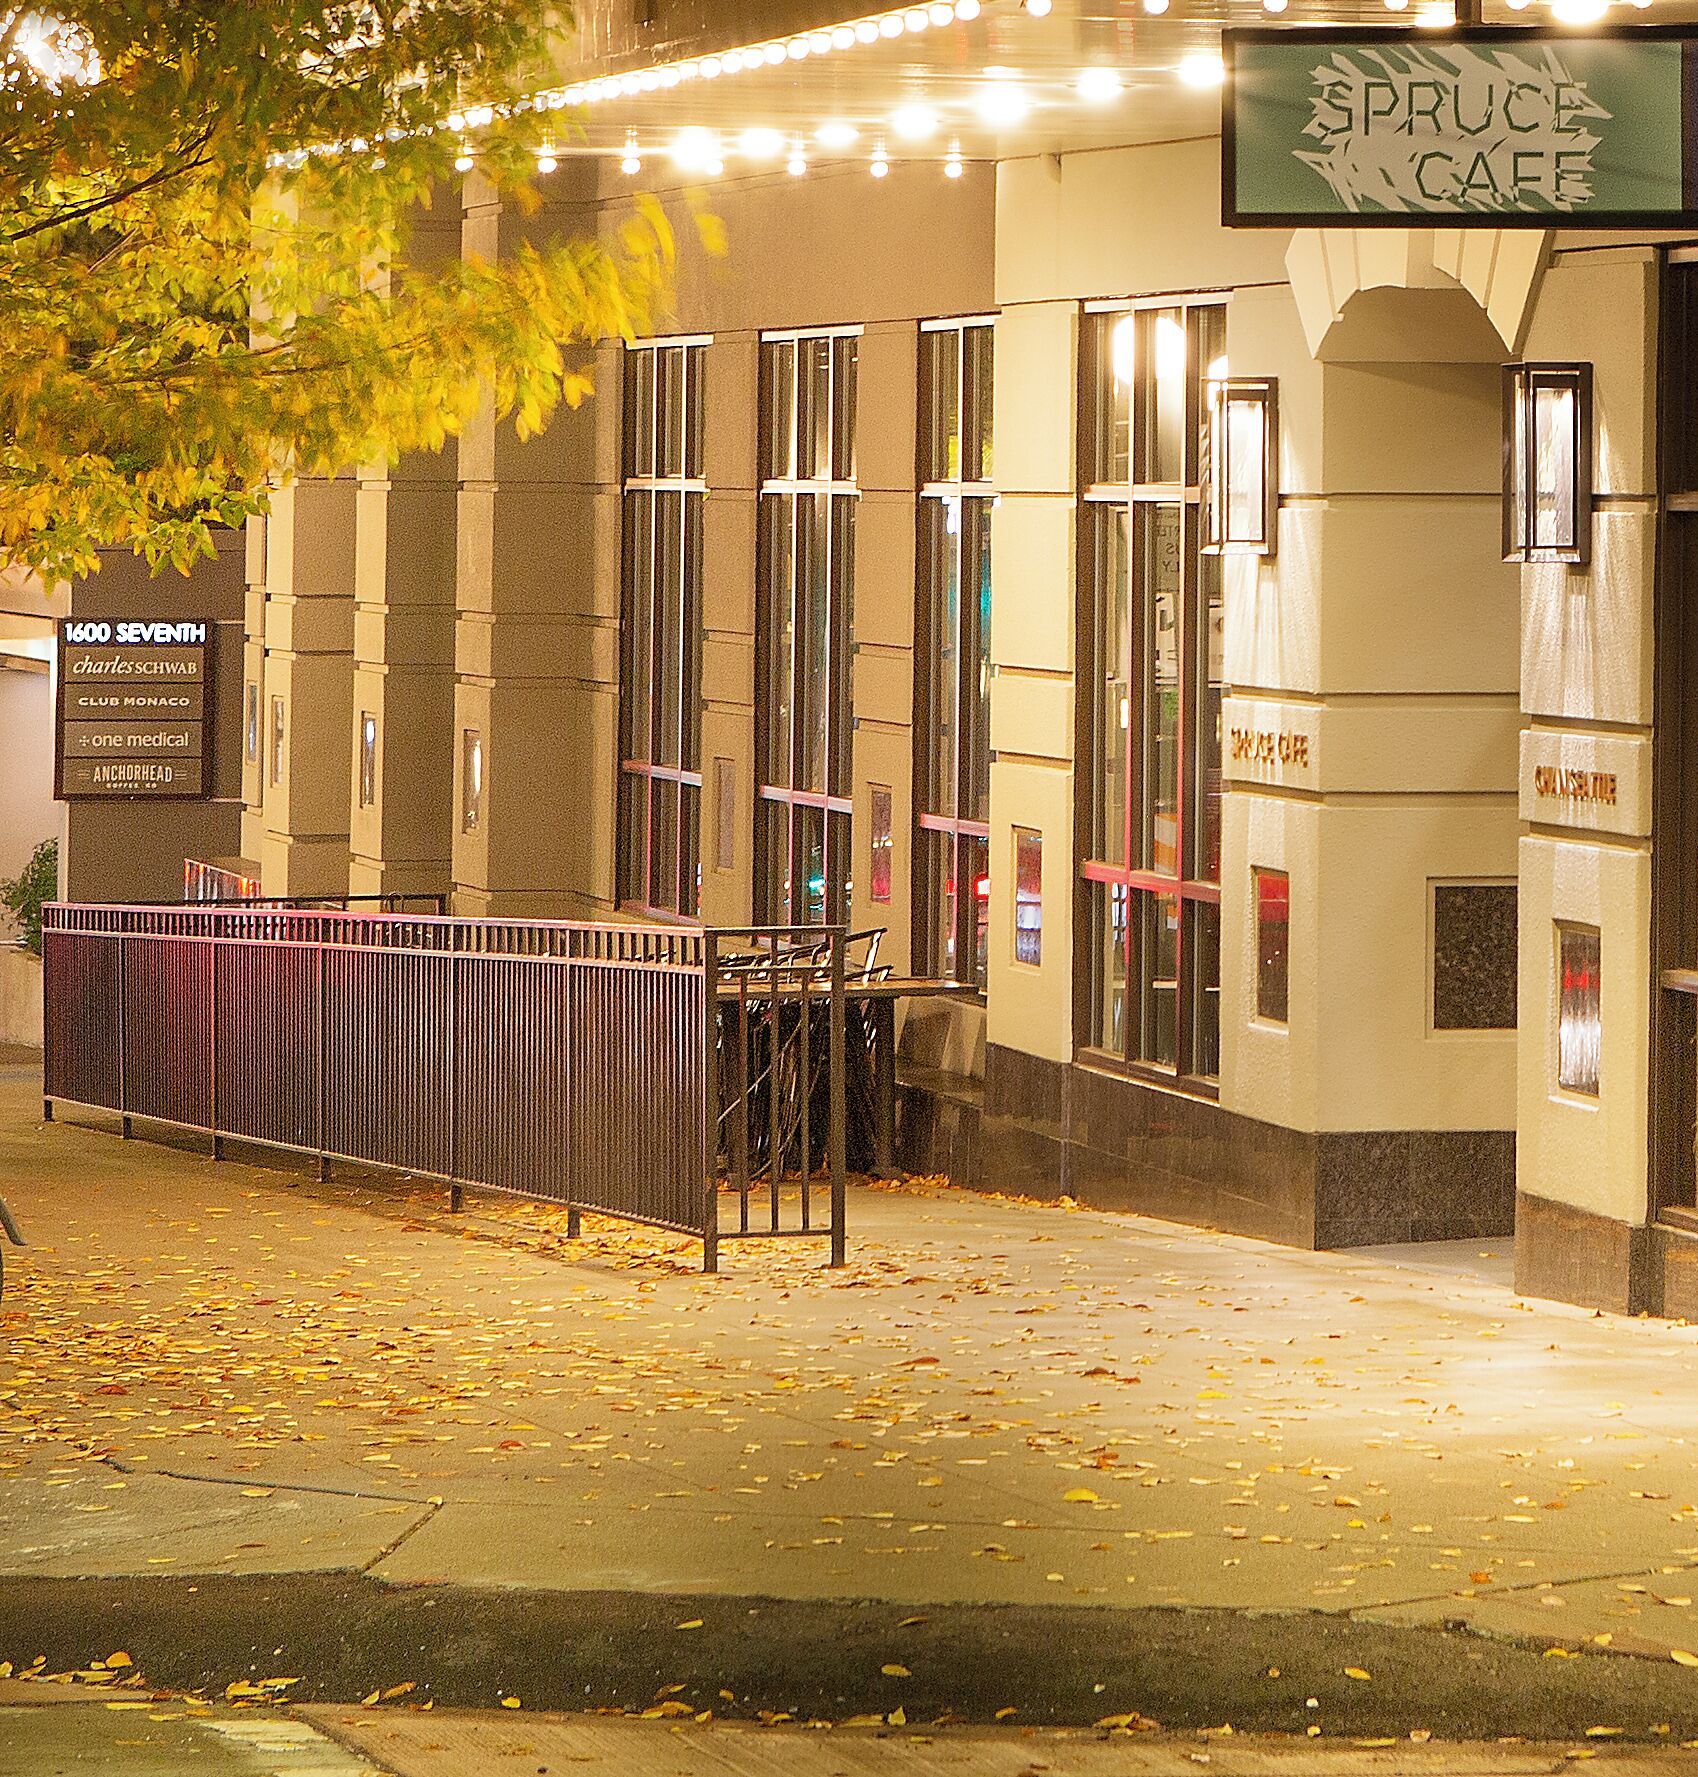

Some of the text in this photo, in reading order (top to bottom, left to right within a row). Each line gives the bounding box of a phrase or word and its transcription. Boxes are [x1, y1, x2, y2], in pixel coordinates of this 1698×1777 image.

[1316, 80, 1588, 136] SPRUCE
[1414, 150, 1588, 204] CAFE
[65, 622, 206, 643] 1600 SEVENTH
[78, 696, 190, 706] CLUB MONACO
[92, 732, 189, 747] one medical
[93, 764, 173, 783] ANCHORHEAD
